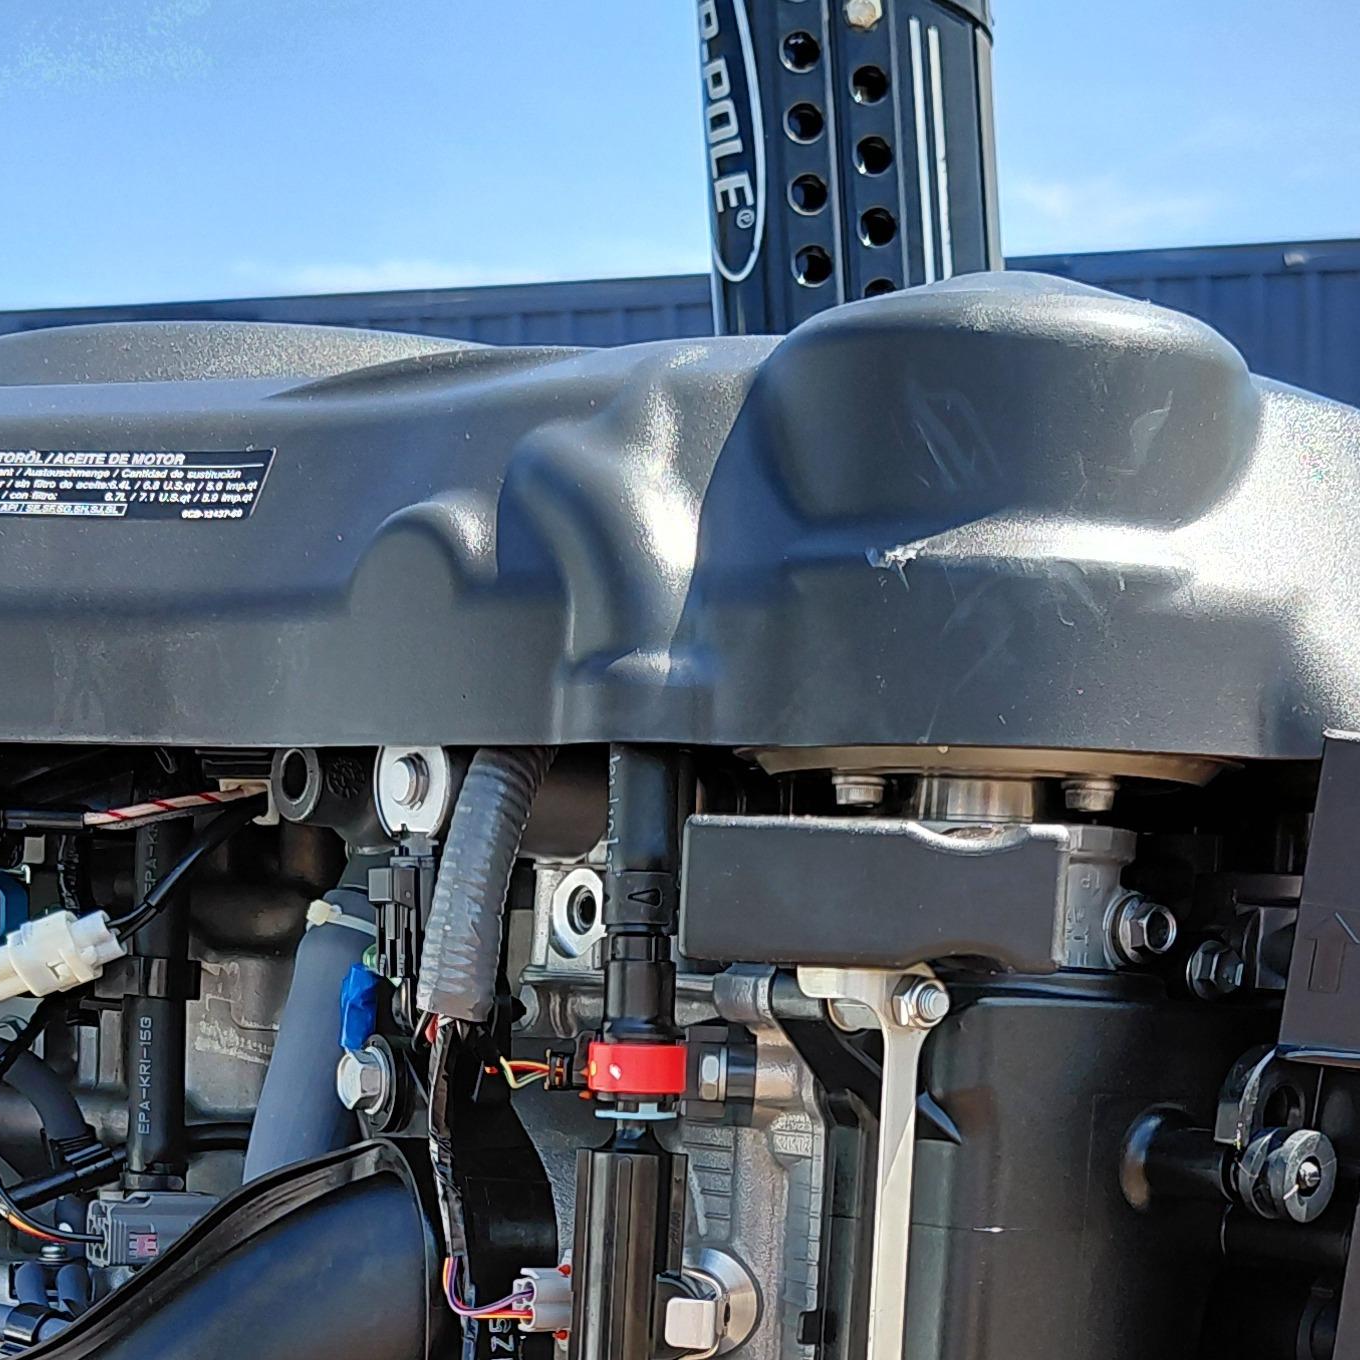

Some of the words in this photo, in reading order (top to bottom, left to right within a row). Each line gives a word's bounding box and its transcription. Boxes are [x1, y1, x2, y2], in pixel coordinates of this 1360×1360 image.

[53, 453, 107, 464] ACEITE
[108, 454, 130, 464] DE
[132, 454, 185, 465] MOTOR
[24, 468, 110, 479] Austauschmenge
[121, 470, 167, 478] Cantidad
[0, 503, 18, 512] API
[139, 1016, 154, 1136] EPA-KRI-15G
